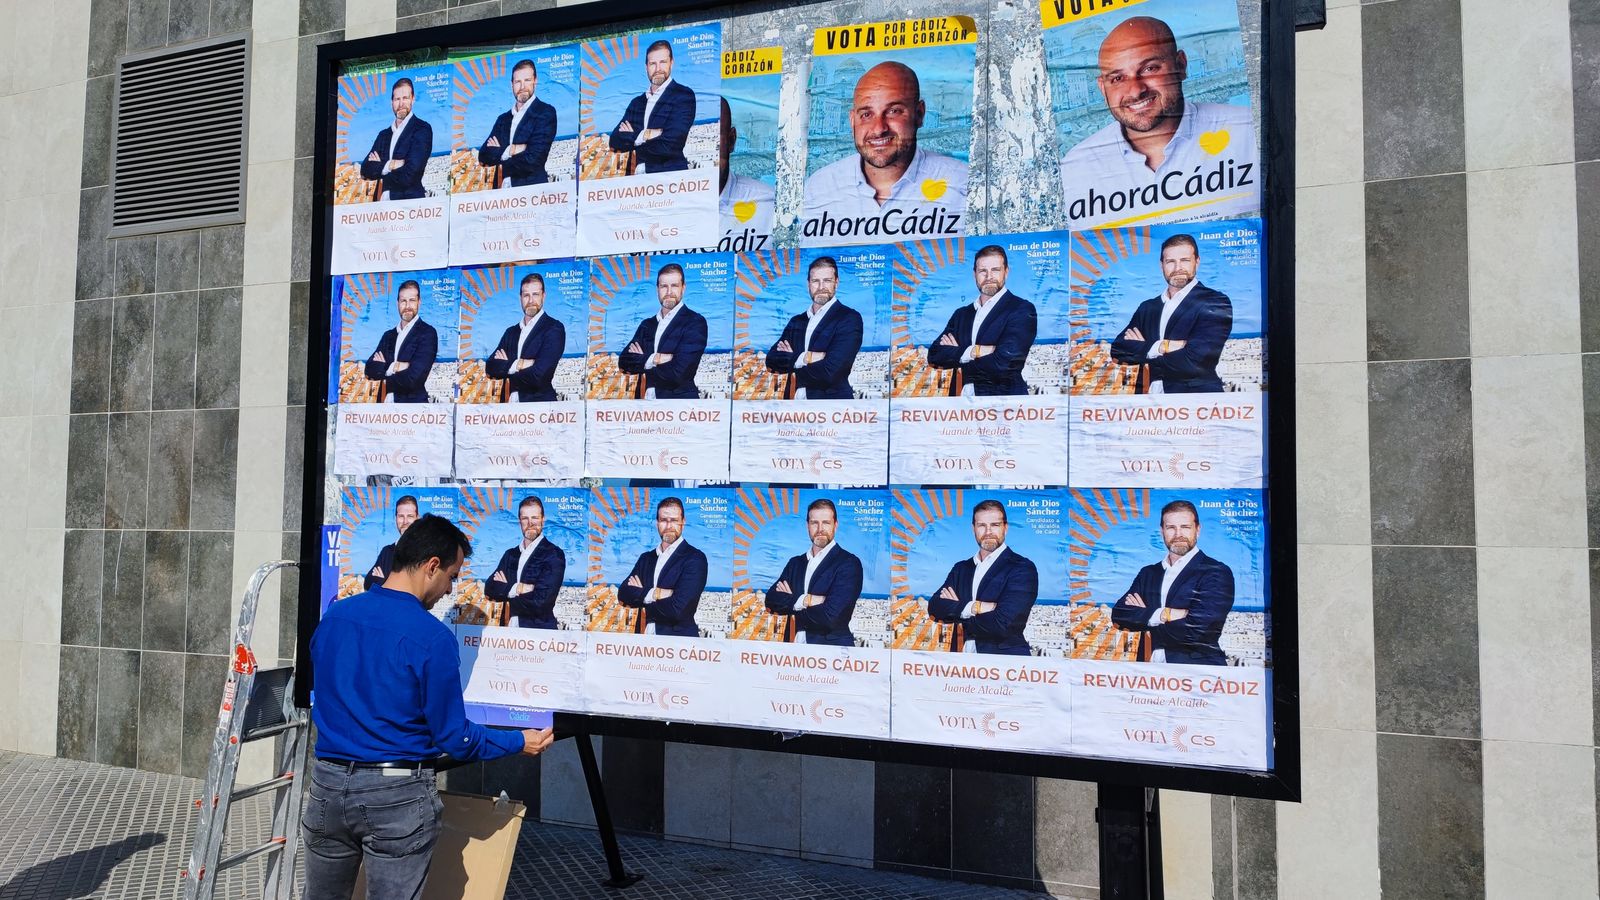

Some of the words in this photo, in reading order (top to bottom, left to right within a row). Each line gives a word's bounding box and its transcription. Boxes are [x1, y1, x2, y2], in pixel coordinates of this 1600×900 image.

[884, 23, 905, 34] POR
[913, 18, 947, 31] CÁDIZ
[673, 37, 689, 45] Juan
[827, 27, 875, 50] VOTA
[884, 35, 905, 47] CON
[913, 28, 967, 44] CORAZÓN
[688, 40, 714, 50] Sánchez
[725, 50, 755, 63] CÁDIZ
[725, 59, 773, 75] CORAZÓN
[587, 184, 664, 202] REVIVAMOS
[668, 178, 710, 194] CÁDIZ
[1069, 158, 1253, 220] ahoraCádiz
[458, 196, 528, 213] REVIVAMOS
[531, 191, 569, 207] CÁDIZ
[618, 201, 644, 212] Juande
[646, 198, 674, 209] Alcalde
[341, 210, 404, 224] REVIVAMOS
[408, 205, 443, 220] CÁDIZ
[803, 207, 960, 237] ahoraCádiz
[615, 229, 645, 241] VOTA
[1199, 232, 1222, 241] Juan
[1224, 231, 1235, 239] de
[1237, 229, 1258, 237] Dios
[482, 240, 509, 252] VOTA
[1008, 243, 1028, 251] Juan
[1030, 242, 1040, 250] de
[1042, 241, 1060, 249] Dios
[1220, 237, 1258, 248] Sánchez
[363, 251, 388, 261] VOTA
[839, 255, 857, 263] Juan
[1026, 249, 1060, 258] Sánchez
[700, 268, 727, 276] Sánchez
[855, 261, 885, 270] Sánchez
[558, 276, 583, 284] Sánchez
[344, 414, 408, 424] REVIVAMOS
[411, 411, 447, 425] CÁDIZ
[464, 413, 535, 425] REVIVAMOS
[539, 409, 577, 424] CÁDIZ
[596, 410, 674, 422] REVIVAMOS
[679, 407, 721, 422] CÁDIZ
[742, 412, 827, 424] REVIVAMOS
[832, 408, 878, 424] CÁDIZ
[901, 409, 997, 422] REVIVAMOS
[1003, 405, 1056, 421] CÁDIZ
[1083, 407, 1189, 421] REVIVAMOS
[1196, 403, 1255, 421] CÁDIZ
[627, 426, 654, 435] Juande
[656, 426, 685, 435] Alcalde
[776, 428, 805, 437] Juande
[807, 428, 838, 437] Alcalde
[940, 426, 973, 436] Juande
[975, 426, 1011, 436] Alcalde
[1126, 426, 1162, 436] Juande
[1164, 426, 1204, 436] Alcalde
[365, 454, 390, 464] VOTA
[489, 456, 517, 466] VOTA
[624, 455, 654, 466] VOTA
[772, 458, 805, 469] VOTA
[936, 458, 973, 470] VOTA
[1121, 460, 1163, 472] VOTA
[1199, 500, 1222, 508] Juan
[1224, 500, 1235, 508] de
[464, 635, 535, 651] REVIVAMOS
[539, 638, 578, 654] CÁDIZ
[595, 643, 674, 659] REVIVAMOS
[679, 646, 722, 662] CÁDIZ
[627, 662, 654, 671] Juande
[655, 663, 685, 673] Alcalde
[741, 651, 827, 669] REVIVAMOS
[833, 655, 880, 673] CÁDIZ
[775, 671, 805, 682] Juande
[807, 673, 839, 684] Alcalde
[903, 663, 1000, 680] REVIVAMOS
[1006, 665, 1058, 684] CÁDIZ
[489, 680, 517, 692] VOTA
[942, 683, 975, 694] Juande
[977, 685, 1013, 696] Alcalde
[1083, 672, 1193, 692] REVIVAMOS
[1199, 676, 1259, 696] CÁDIZ
[623, 690, 654, 703] VOTA
[1128, 694, 1165, 706] Juande
[1168, 696, 1208, 708] Alcalde
[771, 702, 805, 716] VOTA
[939, 715, 976, 730] VOTA
[1124, 729, 1167, 744] VOTA
